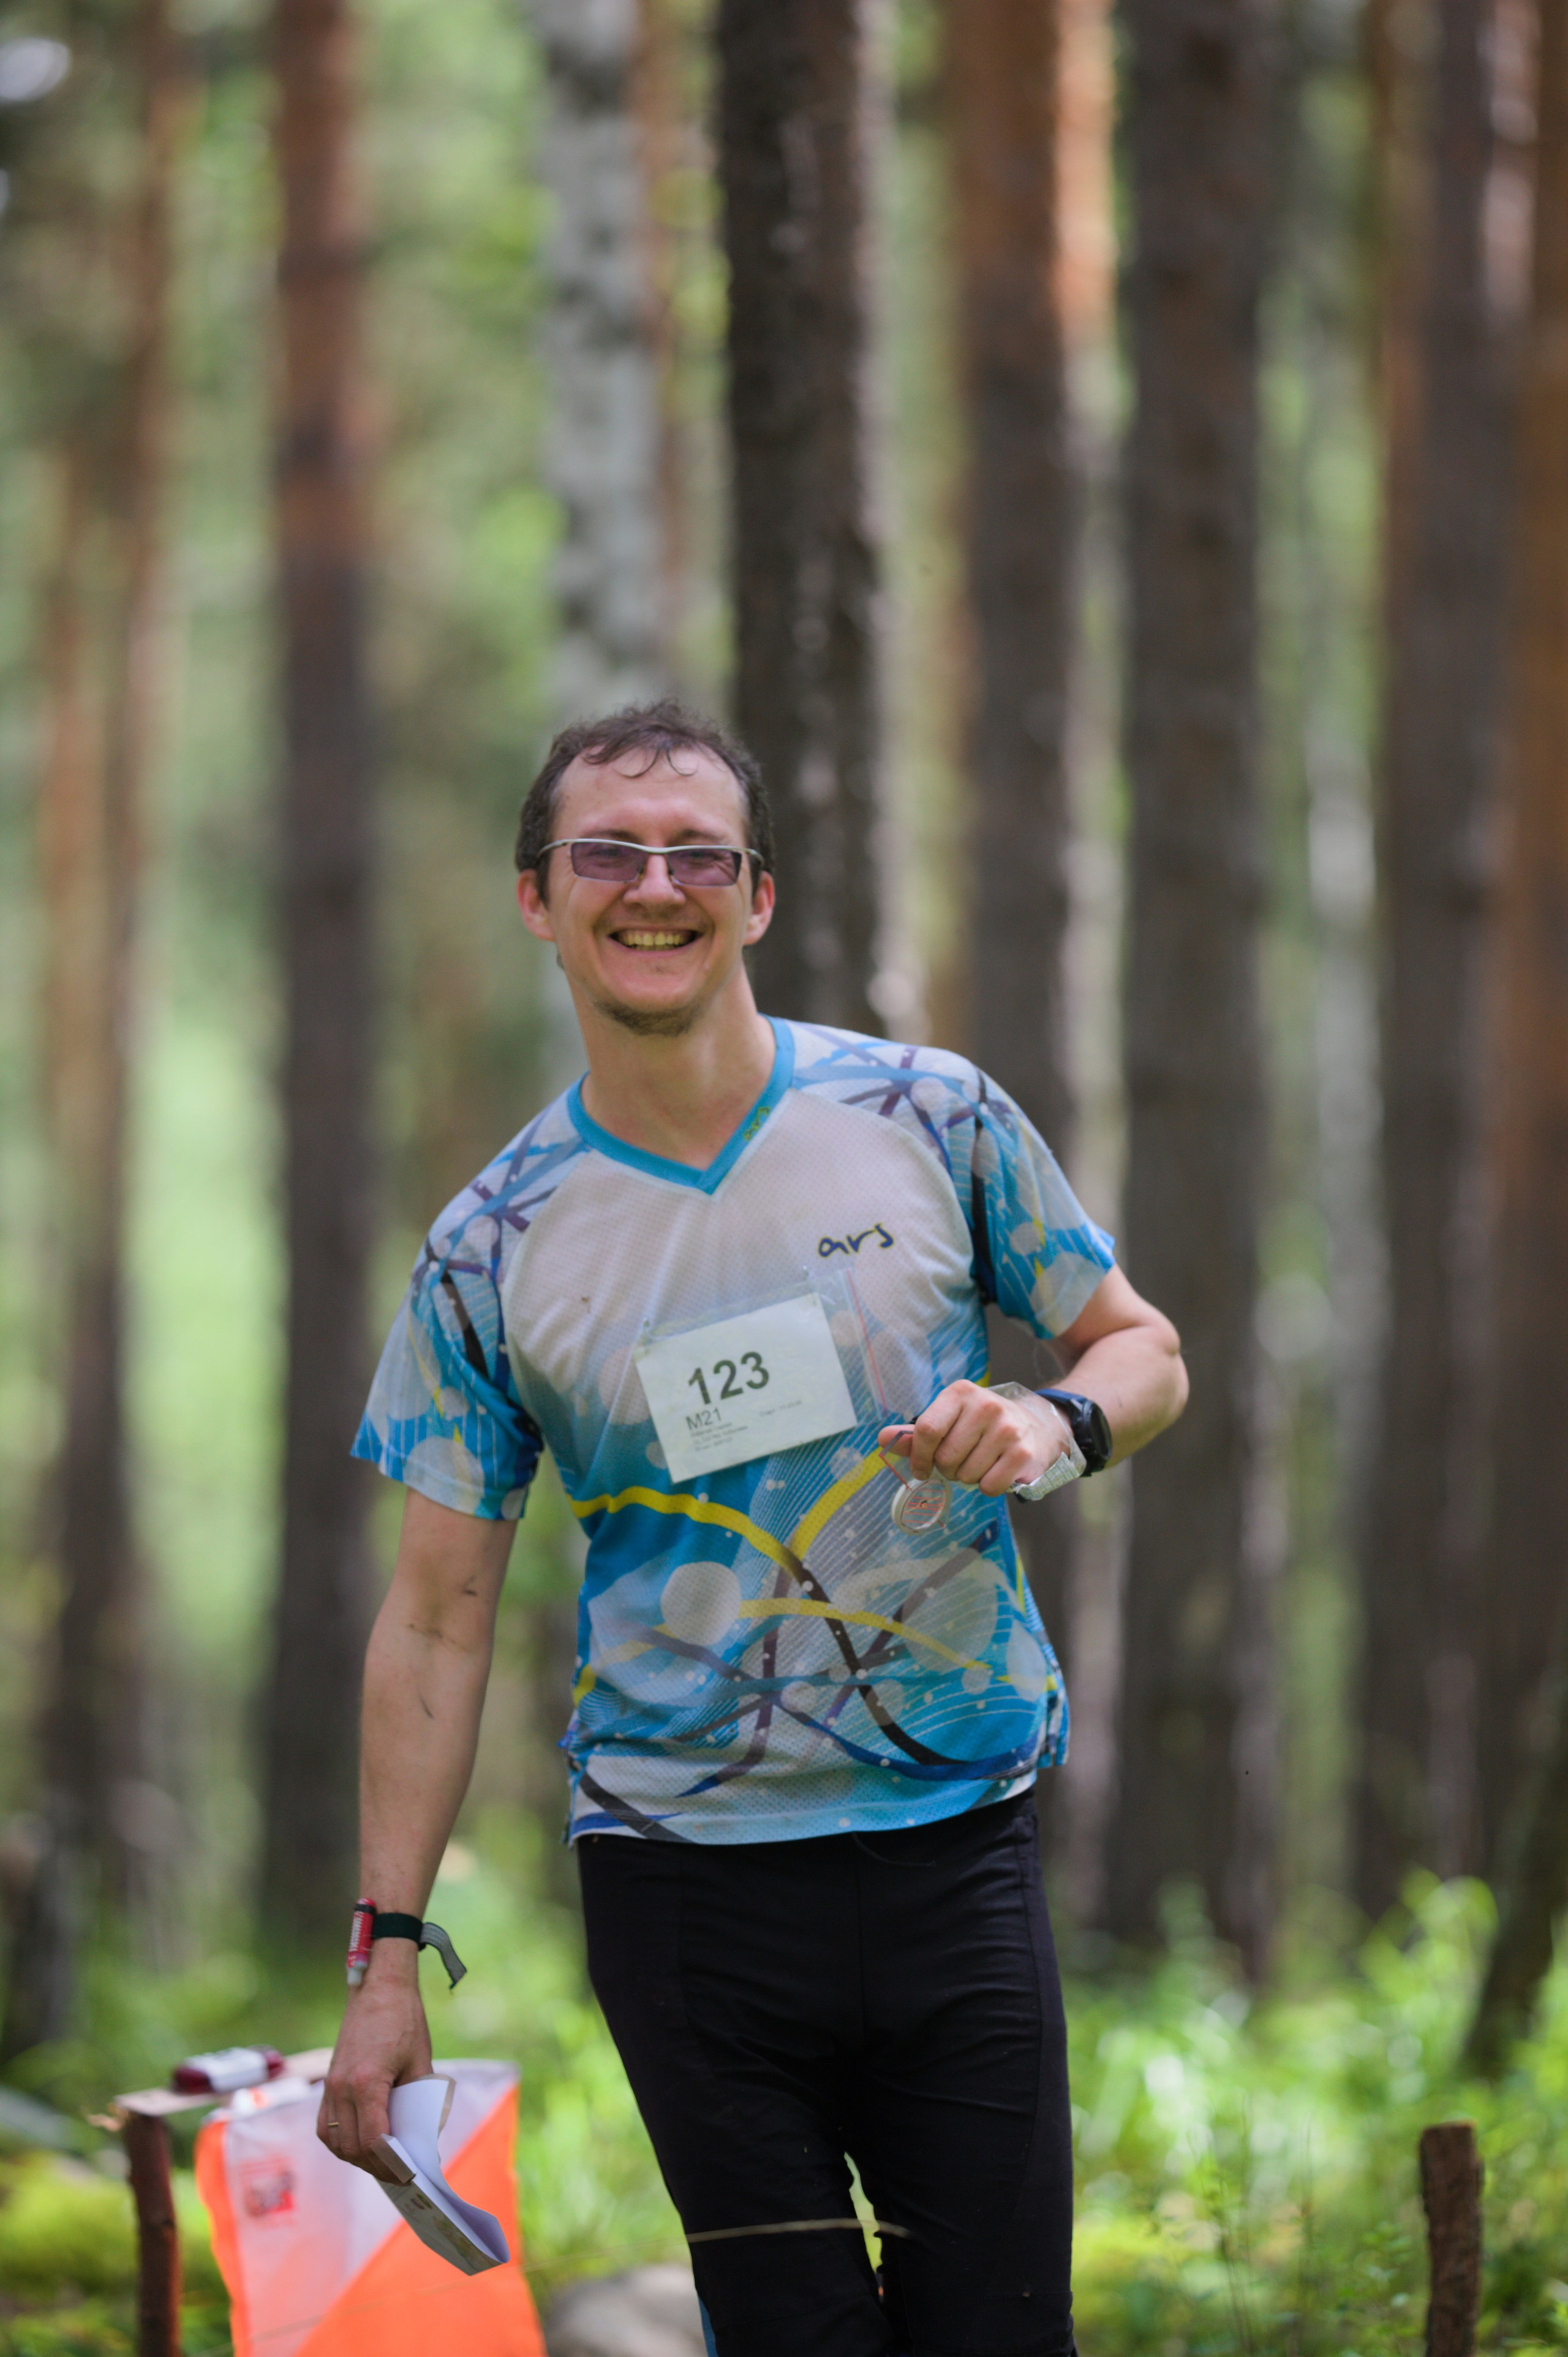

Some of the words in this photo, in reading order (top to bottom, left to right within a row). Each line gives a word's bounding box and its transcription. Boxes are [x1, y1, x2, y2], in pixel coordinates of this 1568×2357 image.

[818, 1223, 894, 1257] ars
[687, 1351, 770, 1405] 123
[685, 1407, 722, 1431] M21
